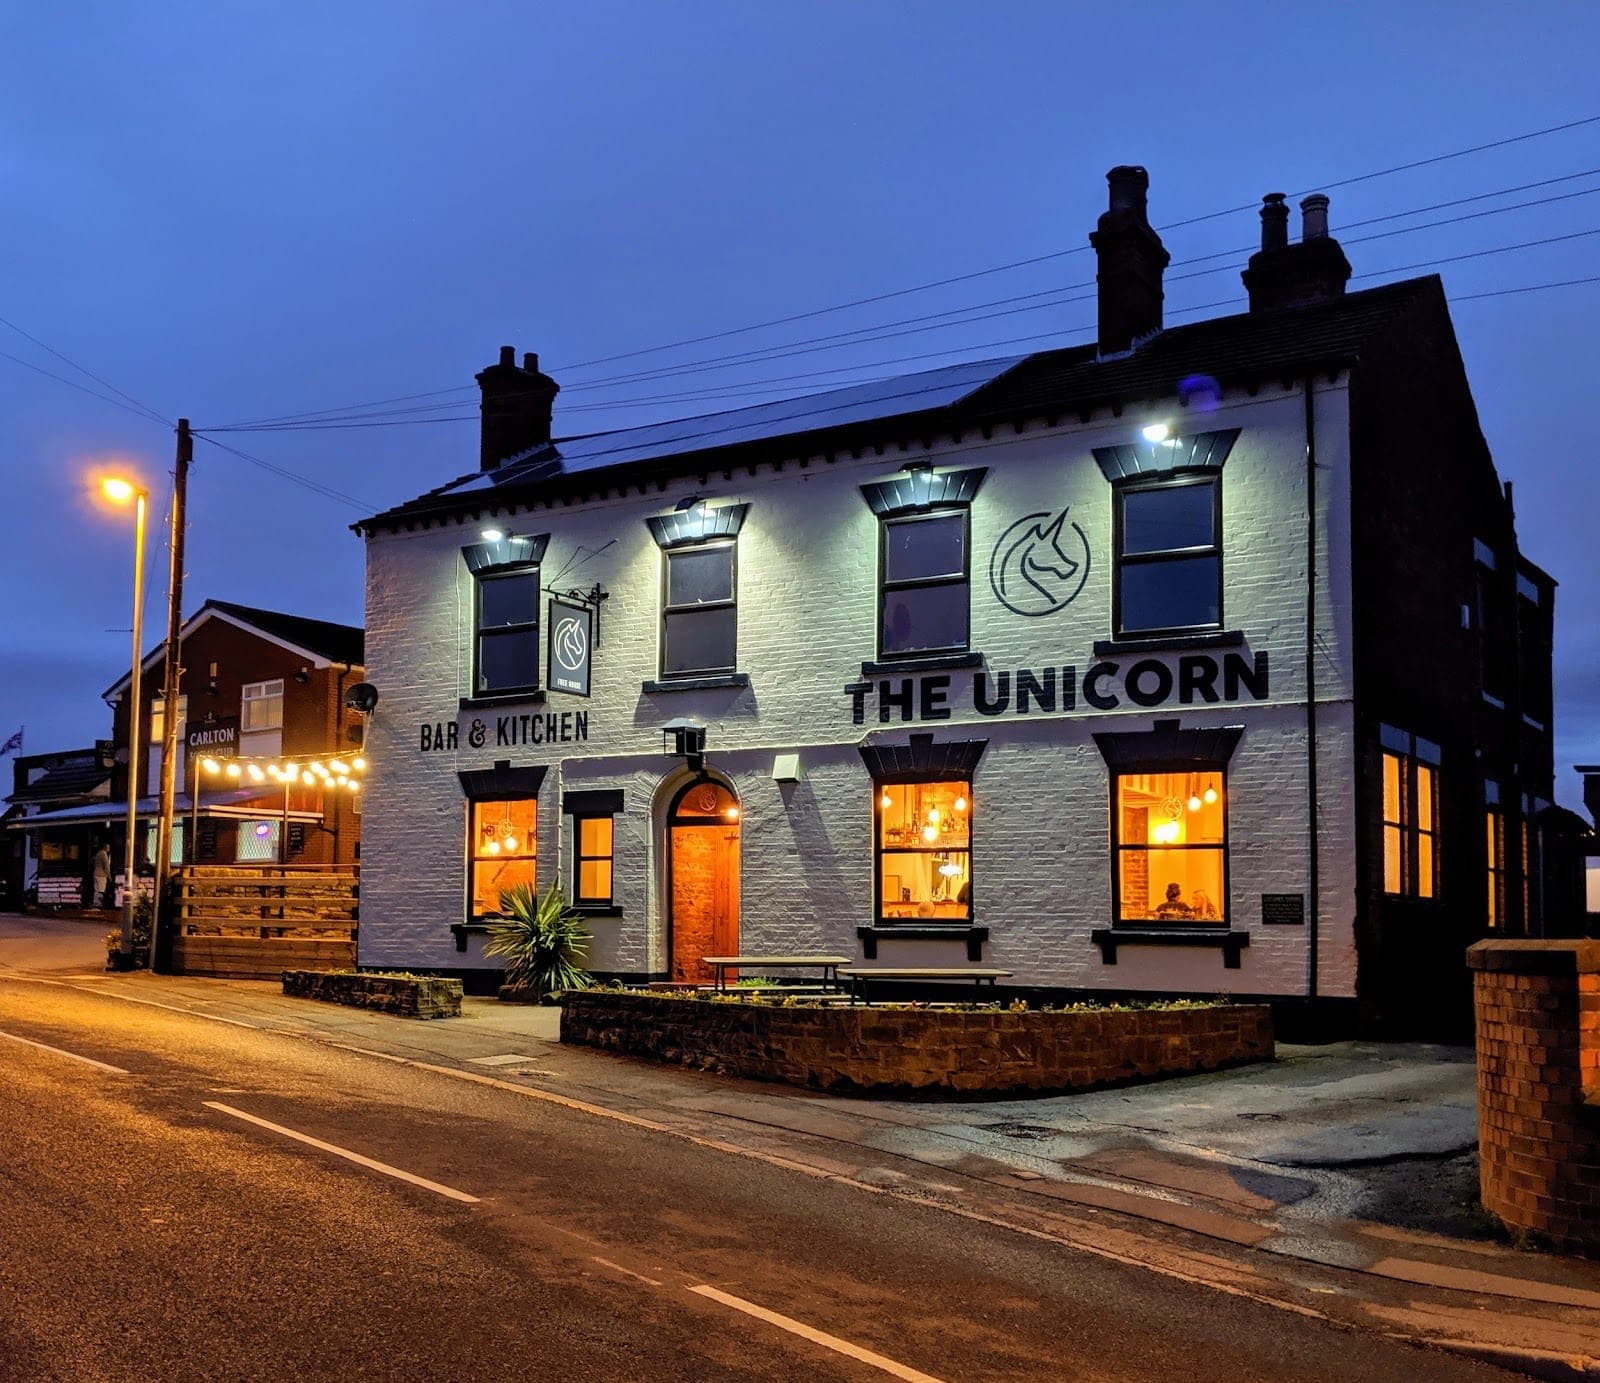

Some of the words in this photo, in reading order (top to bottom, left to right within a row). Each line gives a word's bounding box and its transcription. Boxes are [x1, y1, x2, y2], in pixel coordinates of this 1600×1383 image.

[557, 678, 568, 687] FREE
[844, 674, 951, 725] THE
[973, 650, 1269, 716] UNICORN
[190, 728, 234, 746] CARLTON
[420, 721, 459, 752] BAR
[468, 718, 487, 749] &
[497, 710, 588, 746] KITCHEN
